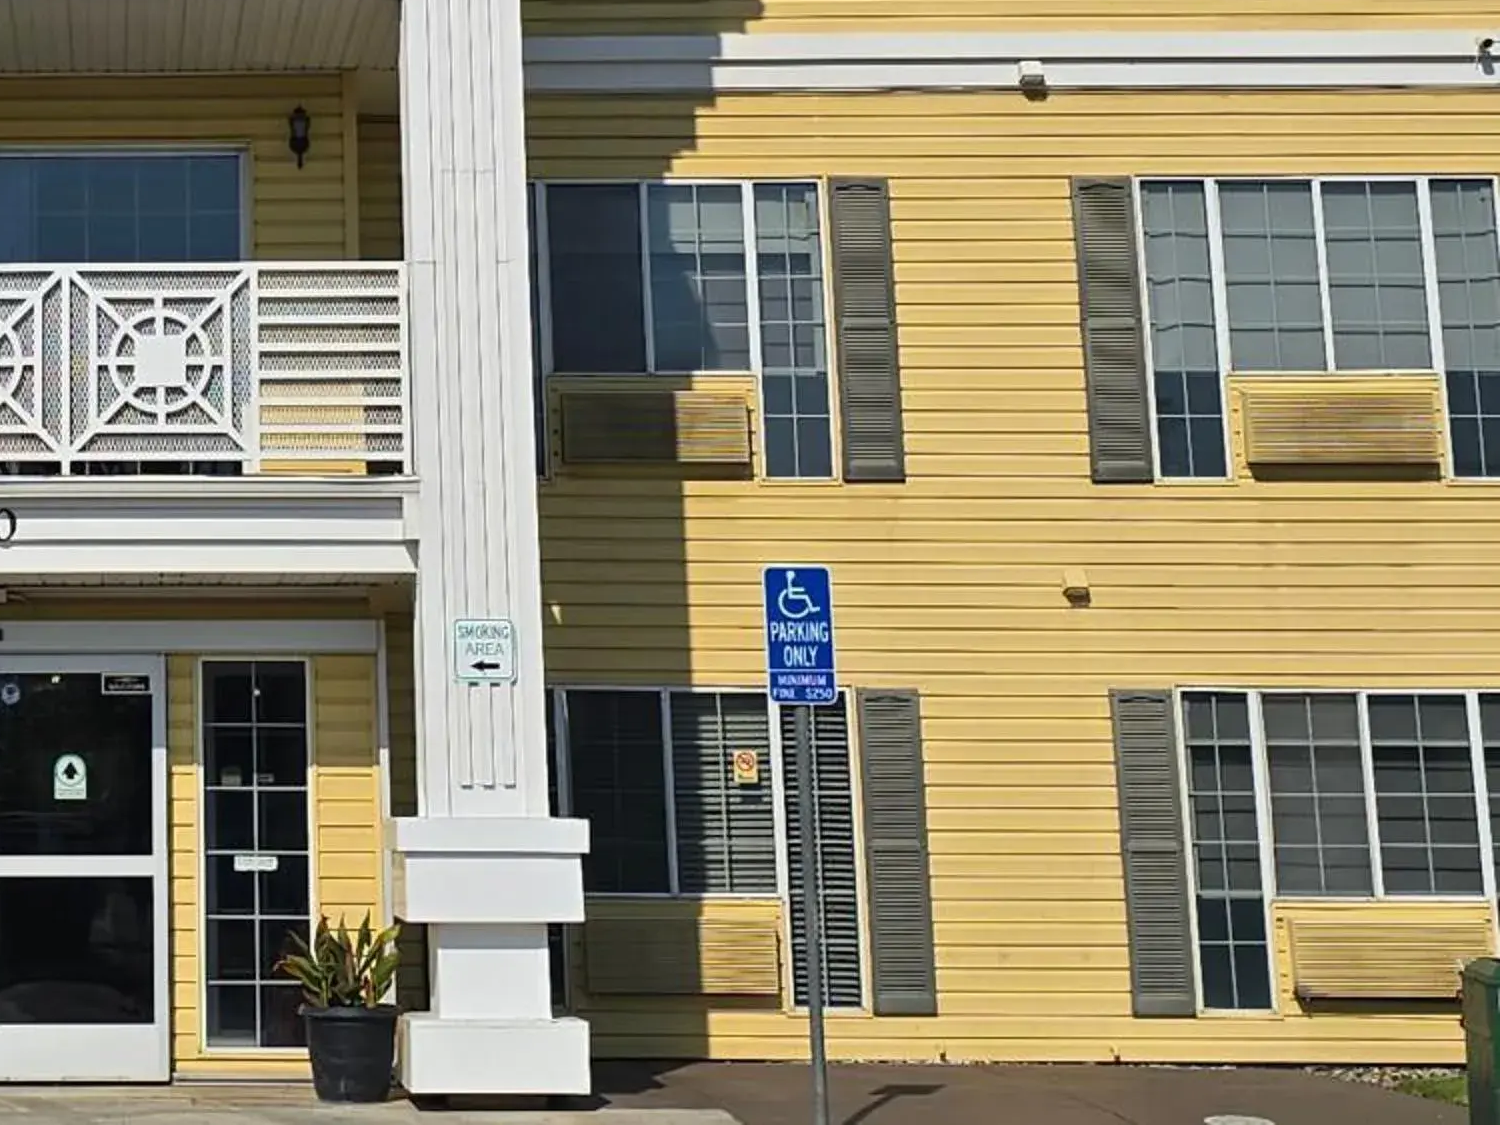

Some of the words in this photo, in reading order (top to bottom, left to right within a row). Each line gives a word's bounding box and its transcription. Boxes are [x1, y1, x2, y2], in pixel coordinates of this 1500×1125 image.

[458, 624, 509, 639] SMOKING
[770, 622, 829, 643] PARKING
[466, 642, 505, 656] AREA
[783, 645, 819, 667] ONLY
[777, 674, 827, 686] MINIMUM
[773, 688, 796, 699] FINE
[805, 687, 833, 700] $250
